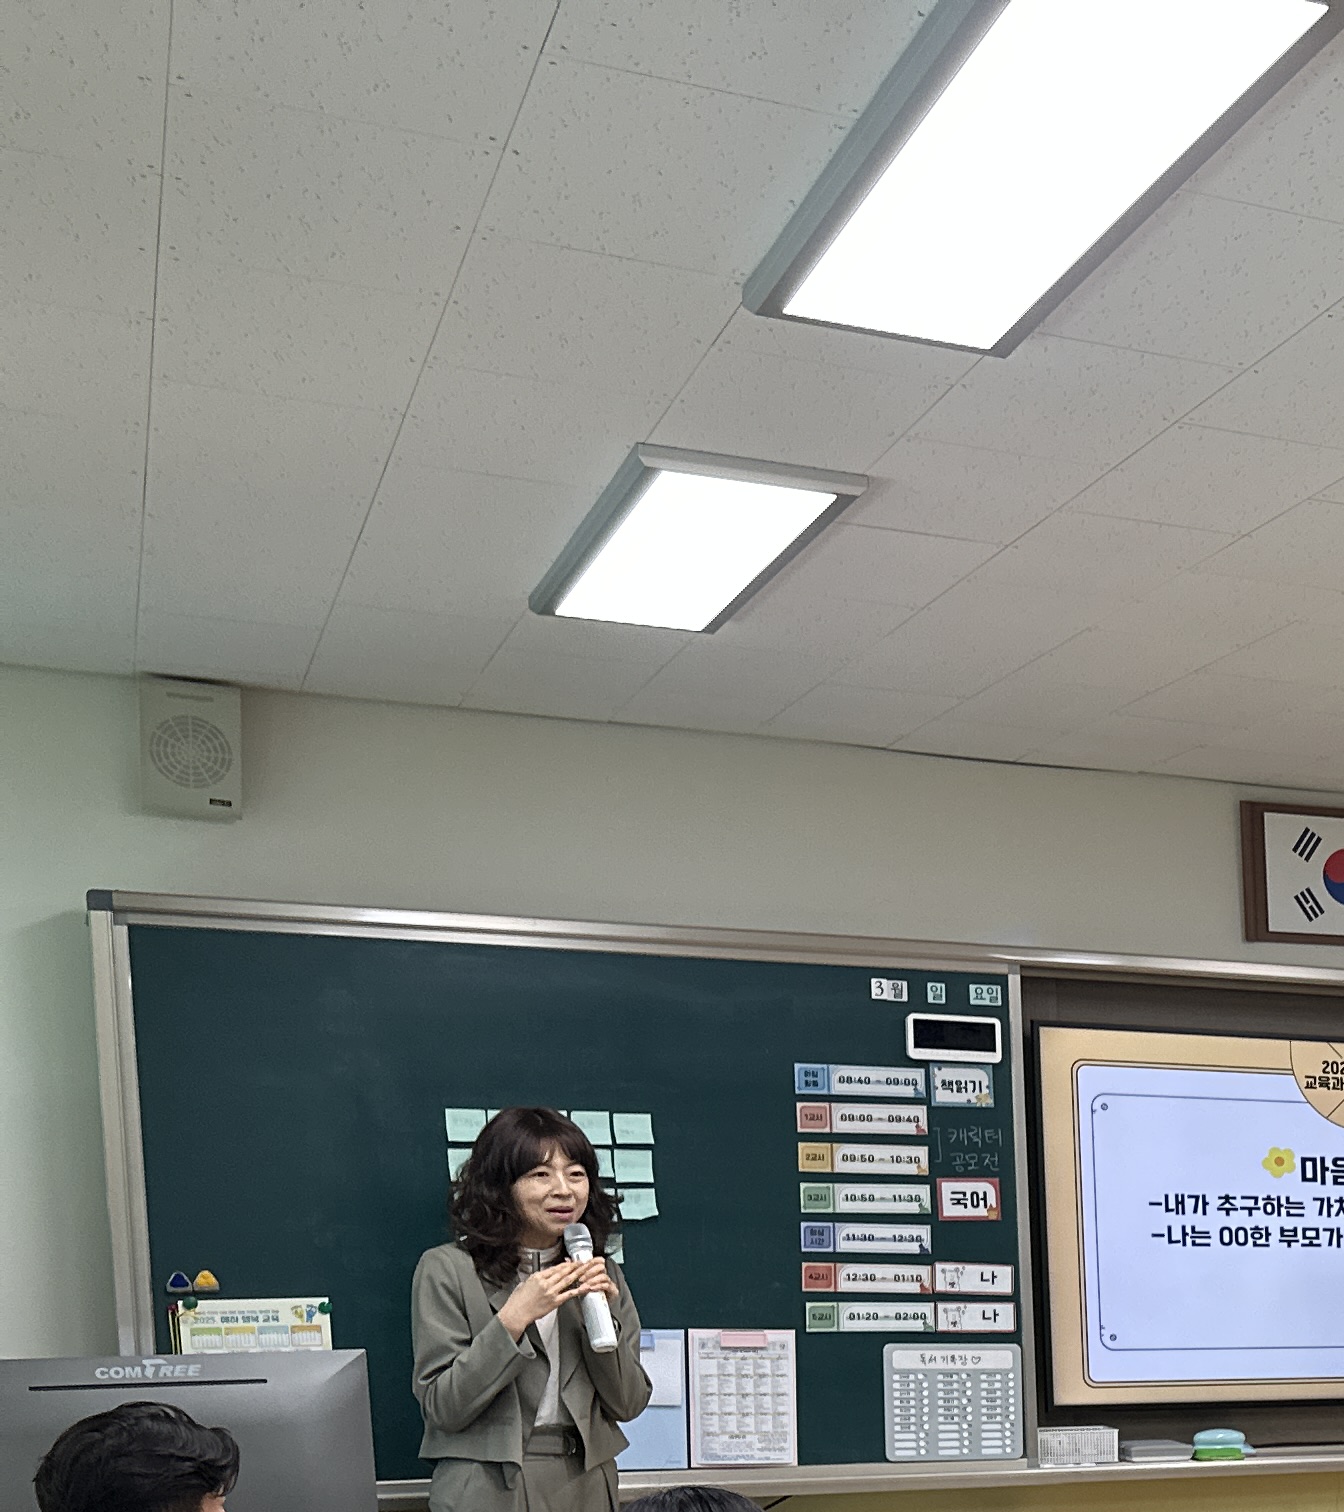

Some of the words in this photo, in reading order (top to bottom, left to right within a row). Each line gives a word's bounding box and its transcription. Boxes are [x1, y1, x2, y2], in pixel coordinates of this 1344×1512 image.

[930, 985, 943, 1001] 일
[973, 987, 999, 1003] 요일
[838, 1075, 871, 1085] 08:40
[941, 1079, 983, 1093] 책읽기
[949, 1126, 1003, 1147] 캐릭터
[890, 1155, 921, 1164] 10:30
[951, 1152, 1000, 1172] 공모전
[950, 1190, 988, 1209] 국어
[1217, 1194, 1305, 1217] 추구하는
[1279, 1226, 1343, 1248] 부모가
[980, 1271, 997, 1285] 나
[982, 1308, 999, 1323] 나
[94, 1358, 202, 1379] COMTREE
